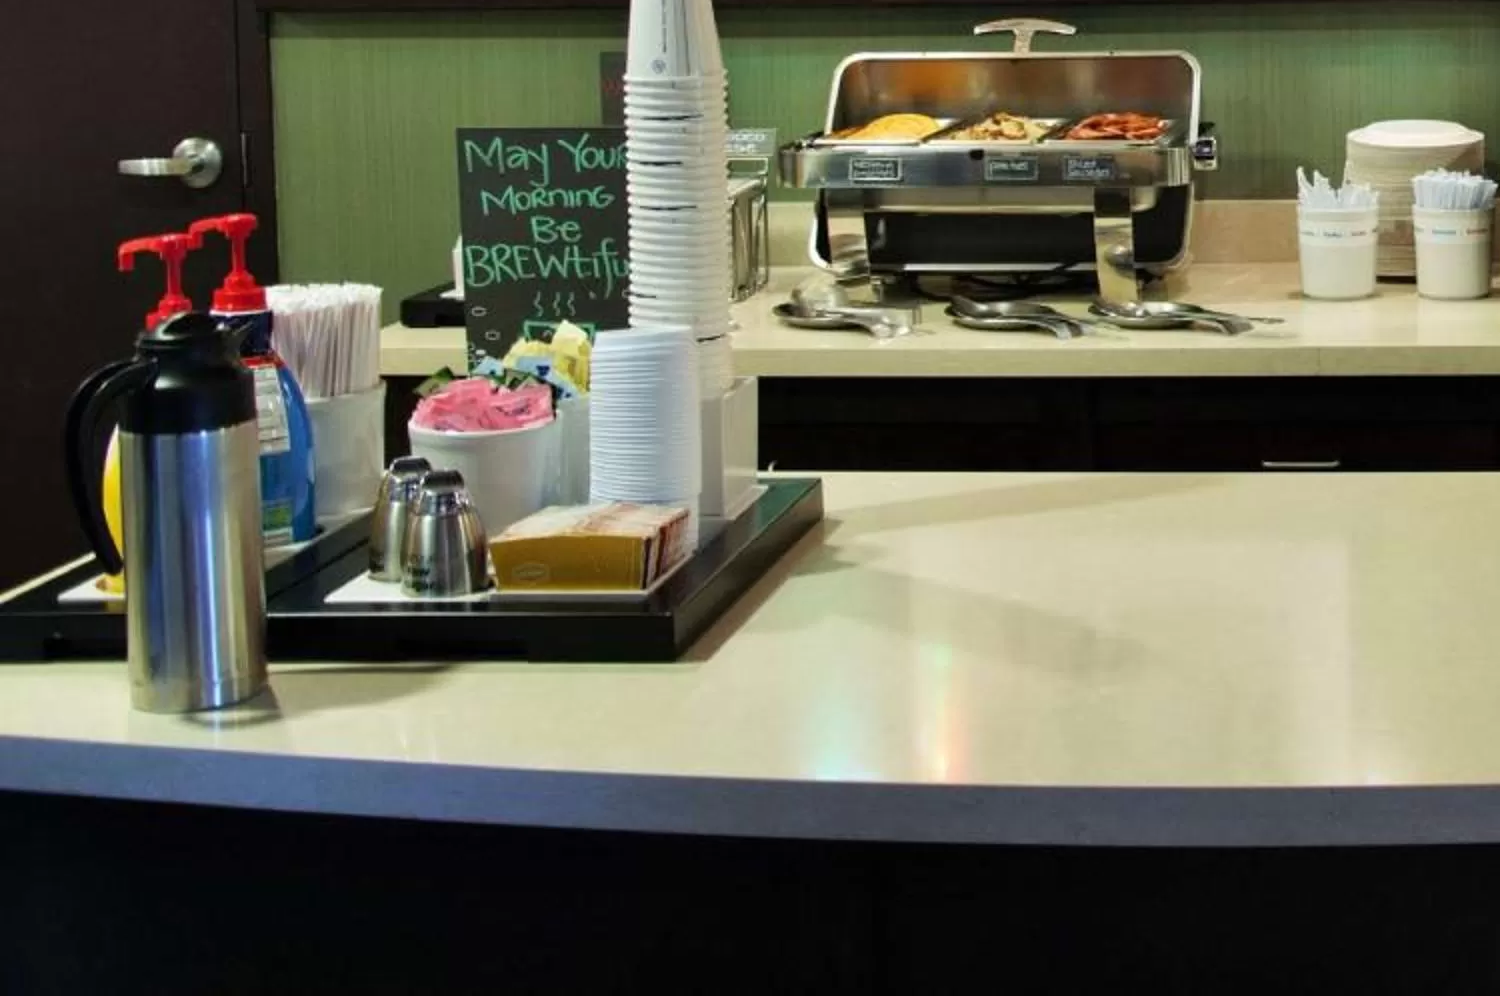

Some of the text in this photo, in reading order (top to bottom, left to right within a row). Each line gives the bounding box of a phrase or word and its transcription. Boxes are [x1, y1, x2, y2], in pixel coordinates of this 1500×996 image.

[464, 136, 548, 188] May
[530, 215, 582, 244] Be
[465, 237, 629, 298] BREWtifu
